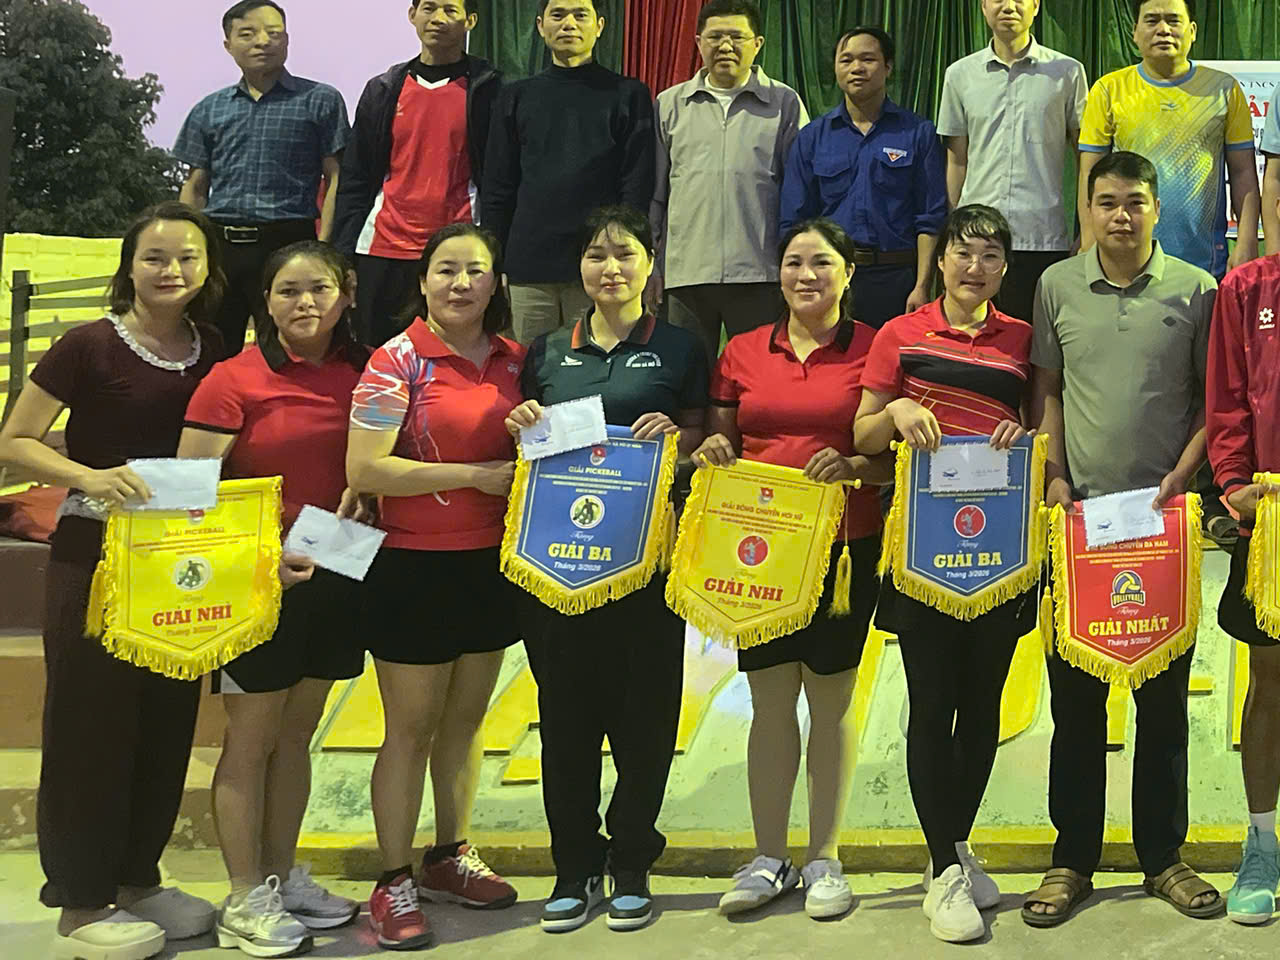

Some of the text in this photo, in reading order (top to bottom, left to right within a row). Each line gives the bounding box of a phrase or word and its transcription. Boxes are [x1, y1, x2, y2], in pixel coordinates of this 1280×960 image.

[548, 540, 612, 561] GIẢI BA
[933, 550, 1003, 569] GIẢI BA
[704, 577, 784, 602] GIẢI NHÌ
[152, 605, 191, 627] GIẢI
[1088, 613, 1169, 637] GIẢI NHẤT
